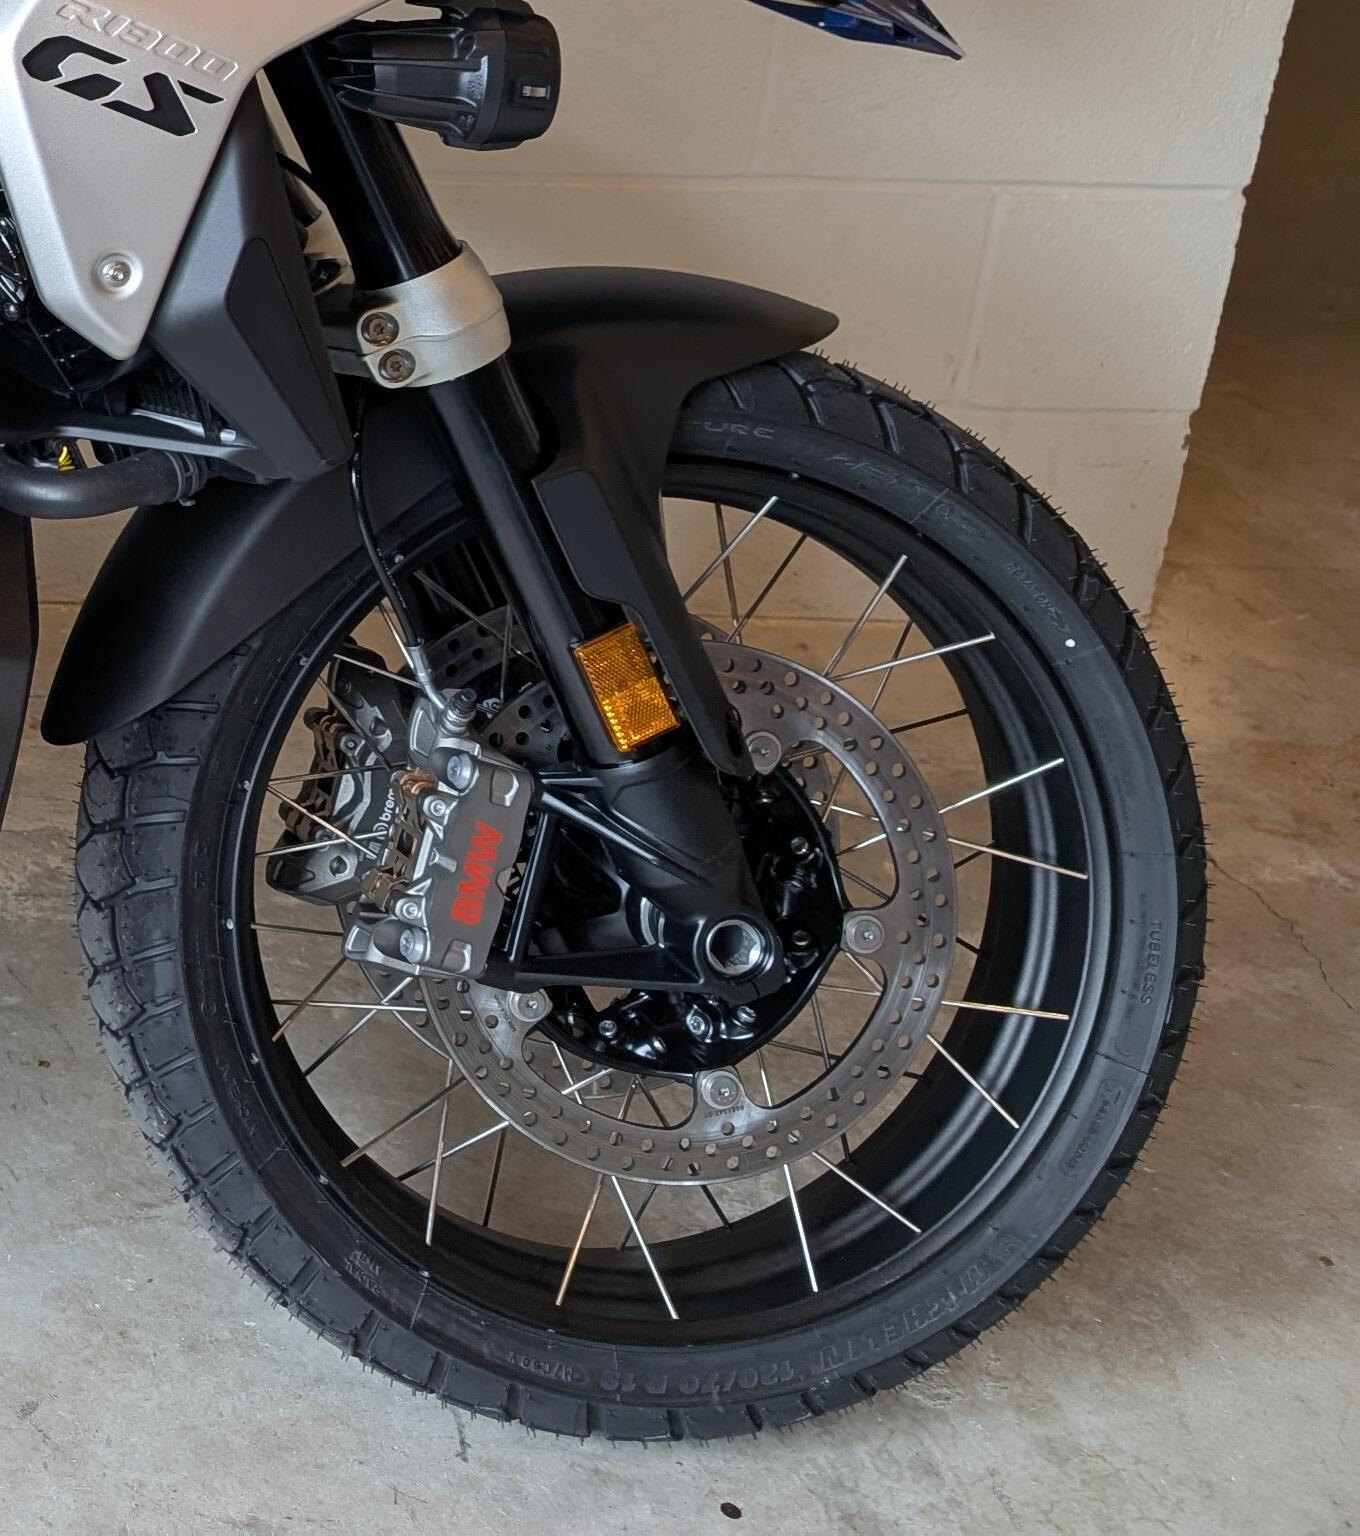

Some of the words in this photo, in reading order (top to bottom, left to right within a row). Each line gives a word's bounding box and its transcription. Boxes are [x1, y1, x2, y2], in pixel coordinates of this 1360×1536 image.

[21, 35, 228, 137] GS
[449, 819, 504, 927] BMW
[1141, 920, 1161, 1006] TUBELESS
[678, 1360, 794, 1395] 120/70
